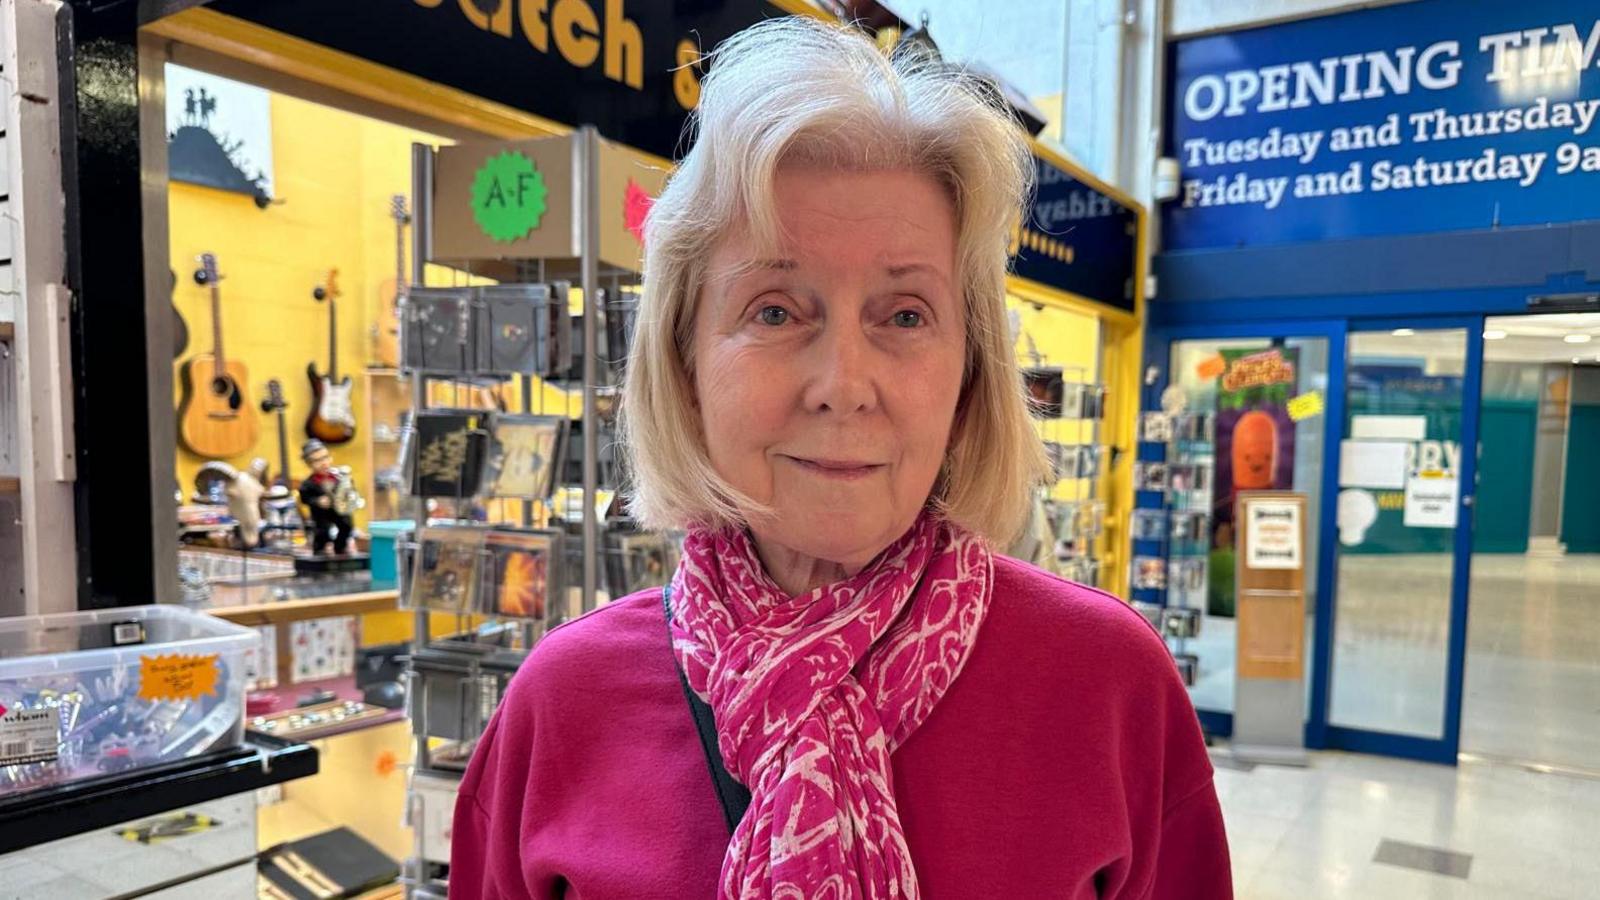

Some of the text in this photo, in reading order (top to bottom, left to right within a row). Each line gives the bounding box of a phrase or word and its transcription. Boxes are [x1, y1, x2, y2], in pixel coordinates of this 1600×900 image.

[1184, 20, 1600, 121] OPENING TIM
[1184, 97, 1600, 167] Tuesday and Thursday
[485, 171, 535, 208] A-F
[1184, 174, 1288, 208] Friday
[1294, 163, 1362, 198] and
[1371, 148, 1547, 187] Saturday
